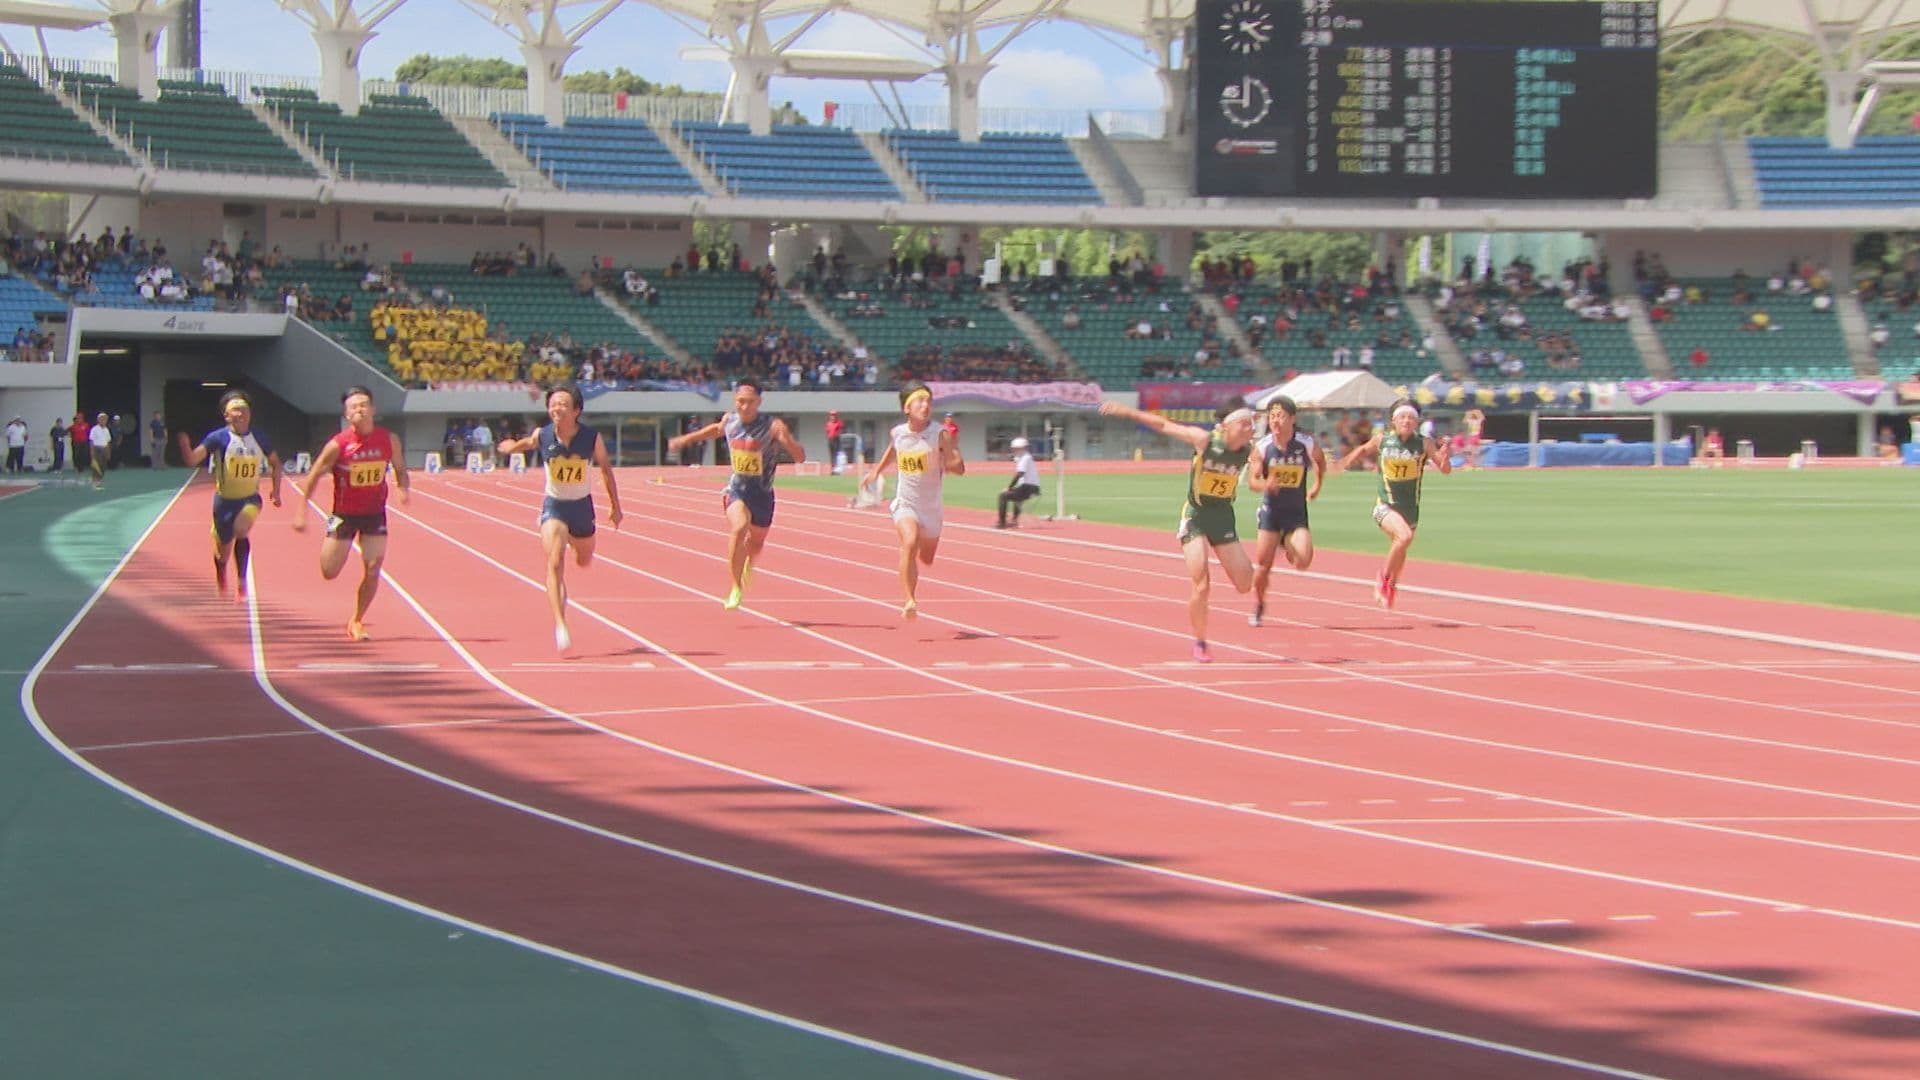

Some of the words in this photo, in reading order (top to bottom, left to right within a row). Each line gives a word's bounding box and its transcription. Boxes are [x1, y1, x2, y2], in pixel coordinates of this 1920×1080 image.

[163, 314, 178, 329] 4
[234, 463, 257, 479] 103
[356, 469, 382, 484] 618
[556, 466, 583, 483] 474
[1393, 465, 1409, 478] 77
[1209, 478, 1229, 496] 75
